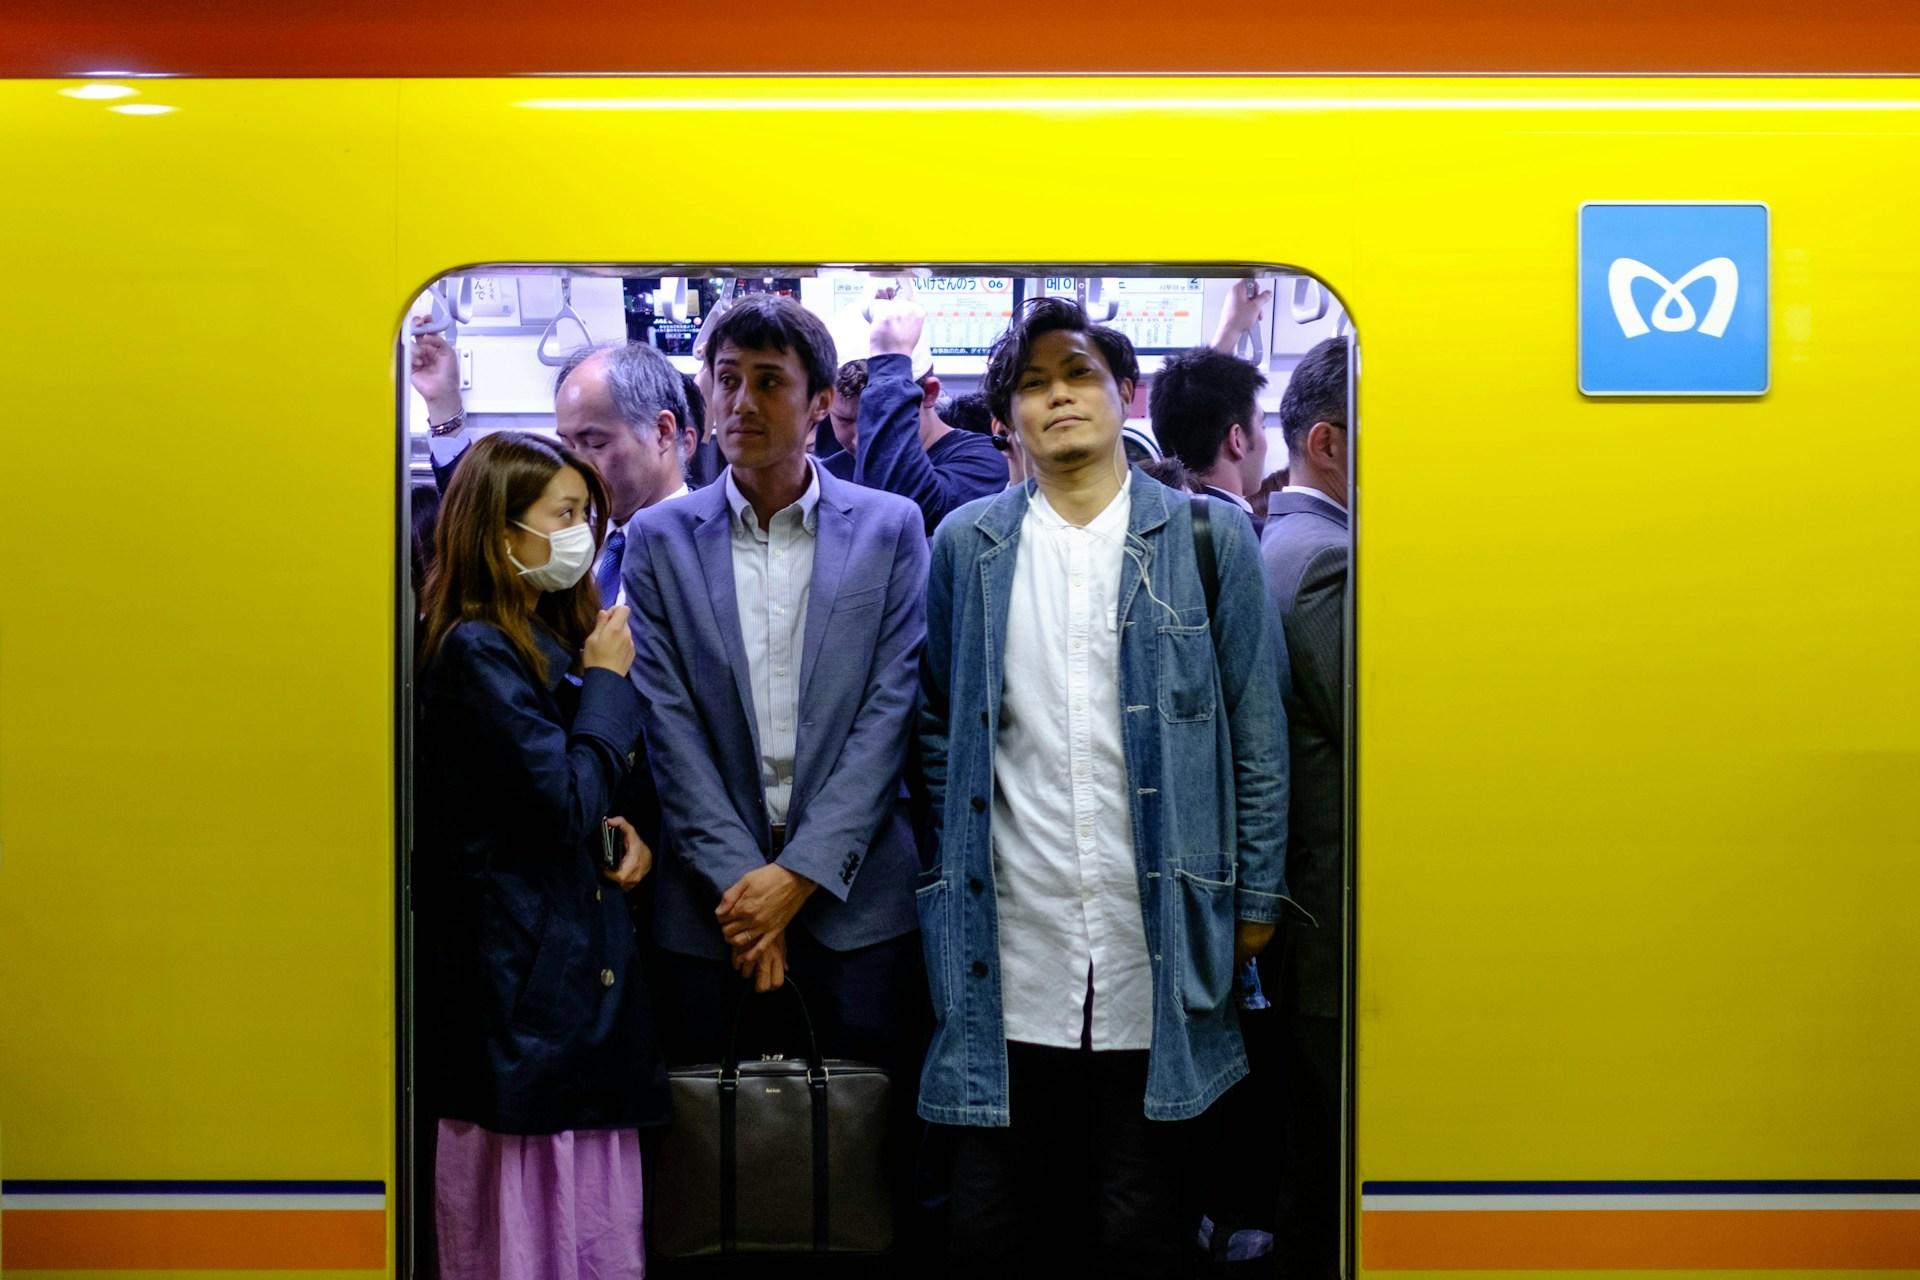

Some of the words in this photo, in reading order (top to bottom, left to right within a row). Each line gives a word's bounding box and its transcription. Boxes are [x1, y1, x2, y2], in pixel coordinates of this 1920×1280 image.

[913, 278, 976, 290] いけさんのう
[988, 280, 1003, 288] 06
